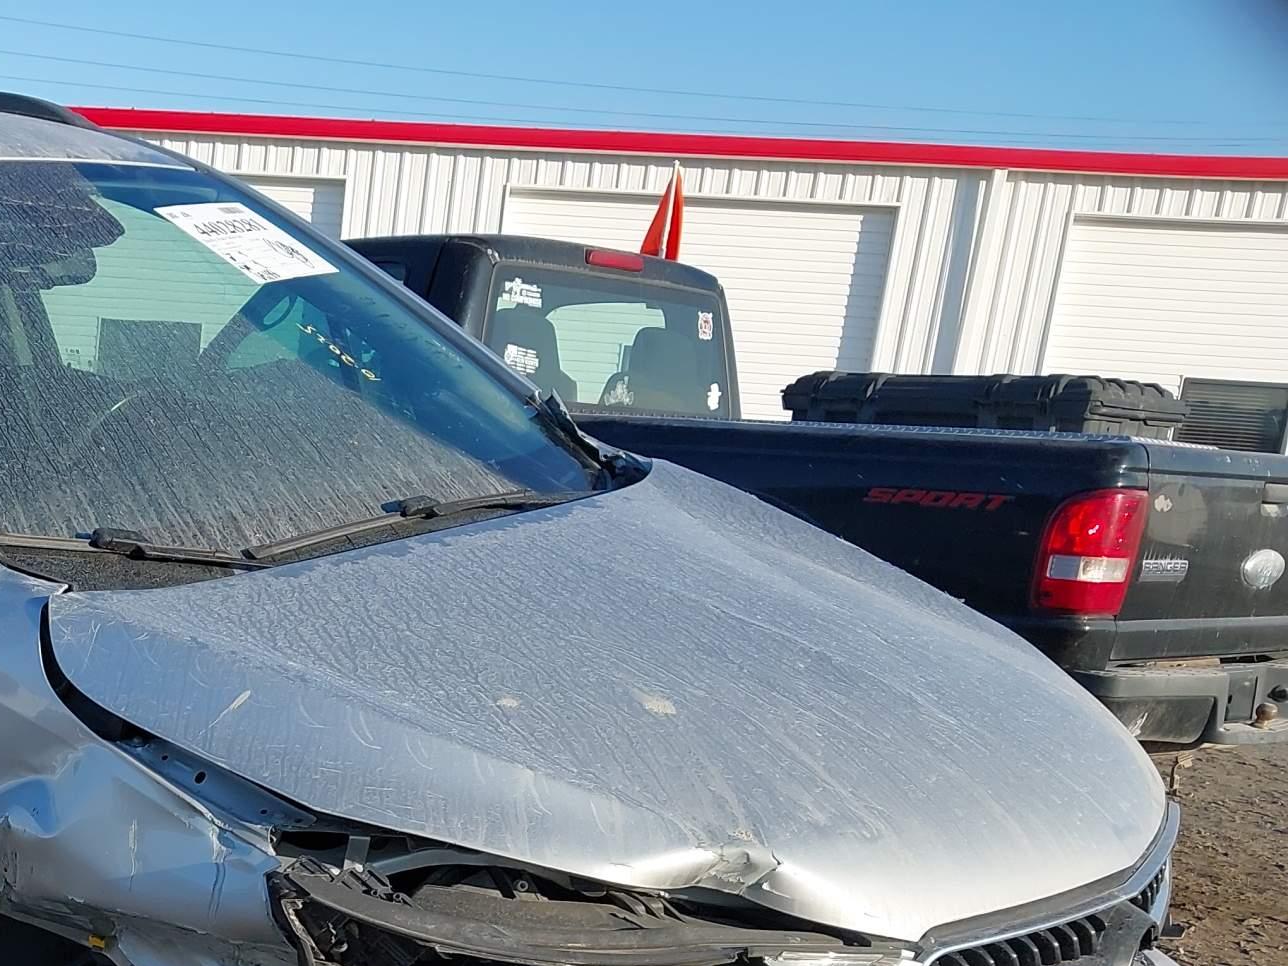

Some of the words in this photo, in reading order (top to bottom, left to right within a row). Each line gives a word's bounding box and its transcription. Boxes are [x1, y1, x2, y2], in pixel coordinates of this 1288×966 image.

[194, 218, 268, 237] 44028281
[863, 487, 1016, 511] SPORT
[1142, 560, 1188, 575] RANGER
